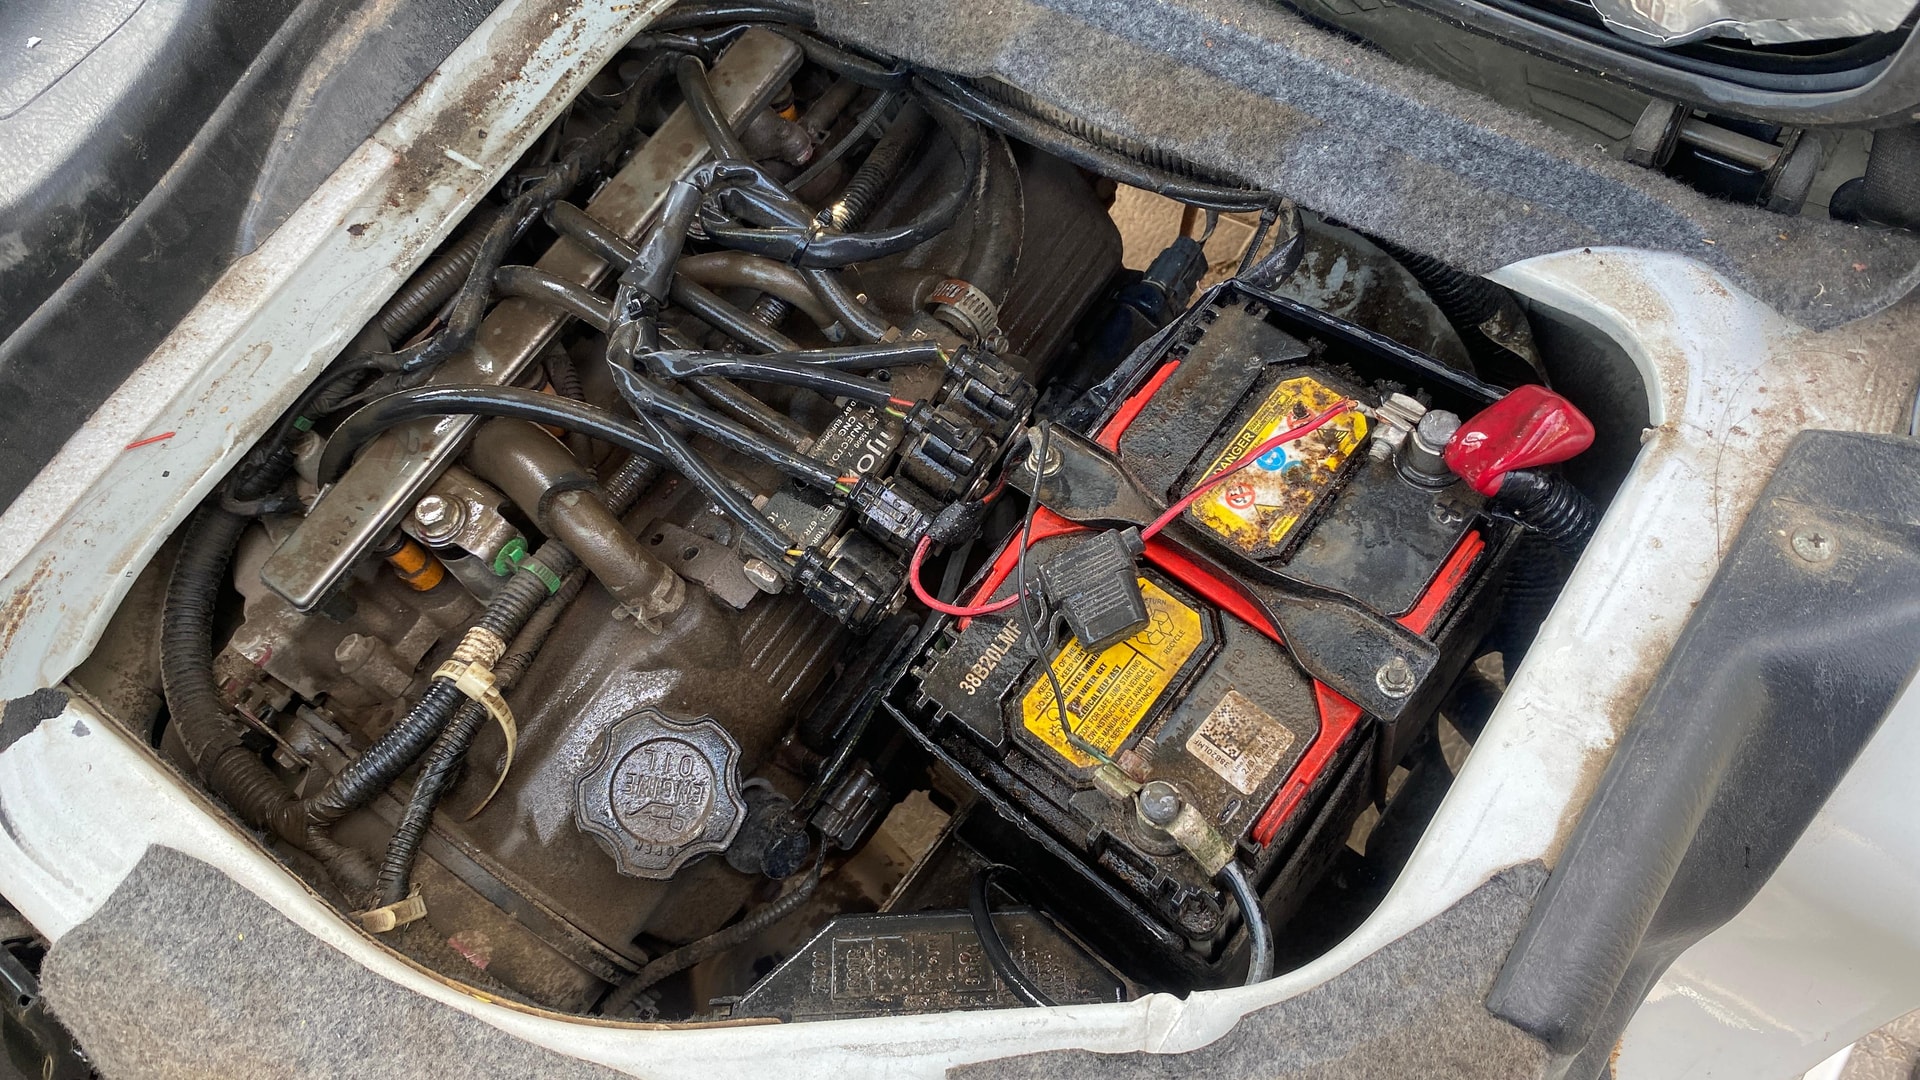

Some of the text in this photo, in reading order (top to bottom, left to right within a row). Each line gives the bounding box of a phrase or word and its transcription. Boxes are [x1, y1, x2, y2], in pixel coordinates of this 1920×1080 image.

[837, 414, 856, 438] CNG
[958, 618, 1023, 696] 38B20LMF
[1163, 628, 1185, 655] RECYCLE
[1035, 677, 1051, 695] KEEP
[1057, 657, 1068, 668] OF
[1064, 645, 1077, 659] THE
[1035, 699, 1046, 711] DO
[1059, 661, 1075, 679] KEEP
[1069, 670, 1085, 687] EYES
[1094, 661, 1108, 675] GET
[1076, 663, 1122, 720] MEDICAL HELP FAST
[1088, 710, 1101, 725] FOR
[1097, 697, 1112, 713] SAFE
[1107, 682, 1123, 700] JUMP
[1119, 658, 1142, 686] STARTING
[1094, 691, 1127, 731] INSTRUCTIONS
[1127, 664, 1148, 689] VEHICLE
[1123, 695, 1135, 709] NOT
[1131, 667, 1157, 698] AVAILABLE
[1110, 716, 1130, 741] SERVICE
[642, 749, 694, 778] OIL
[621, 771, 704, 805] ENGINE
